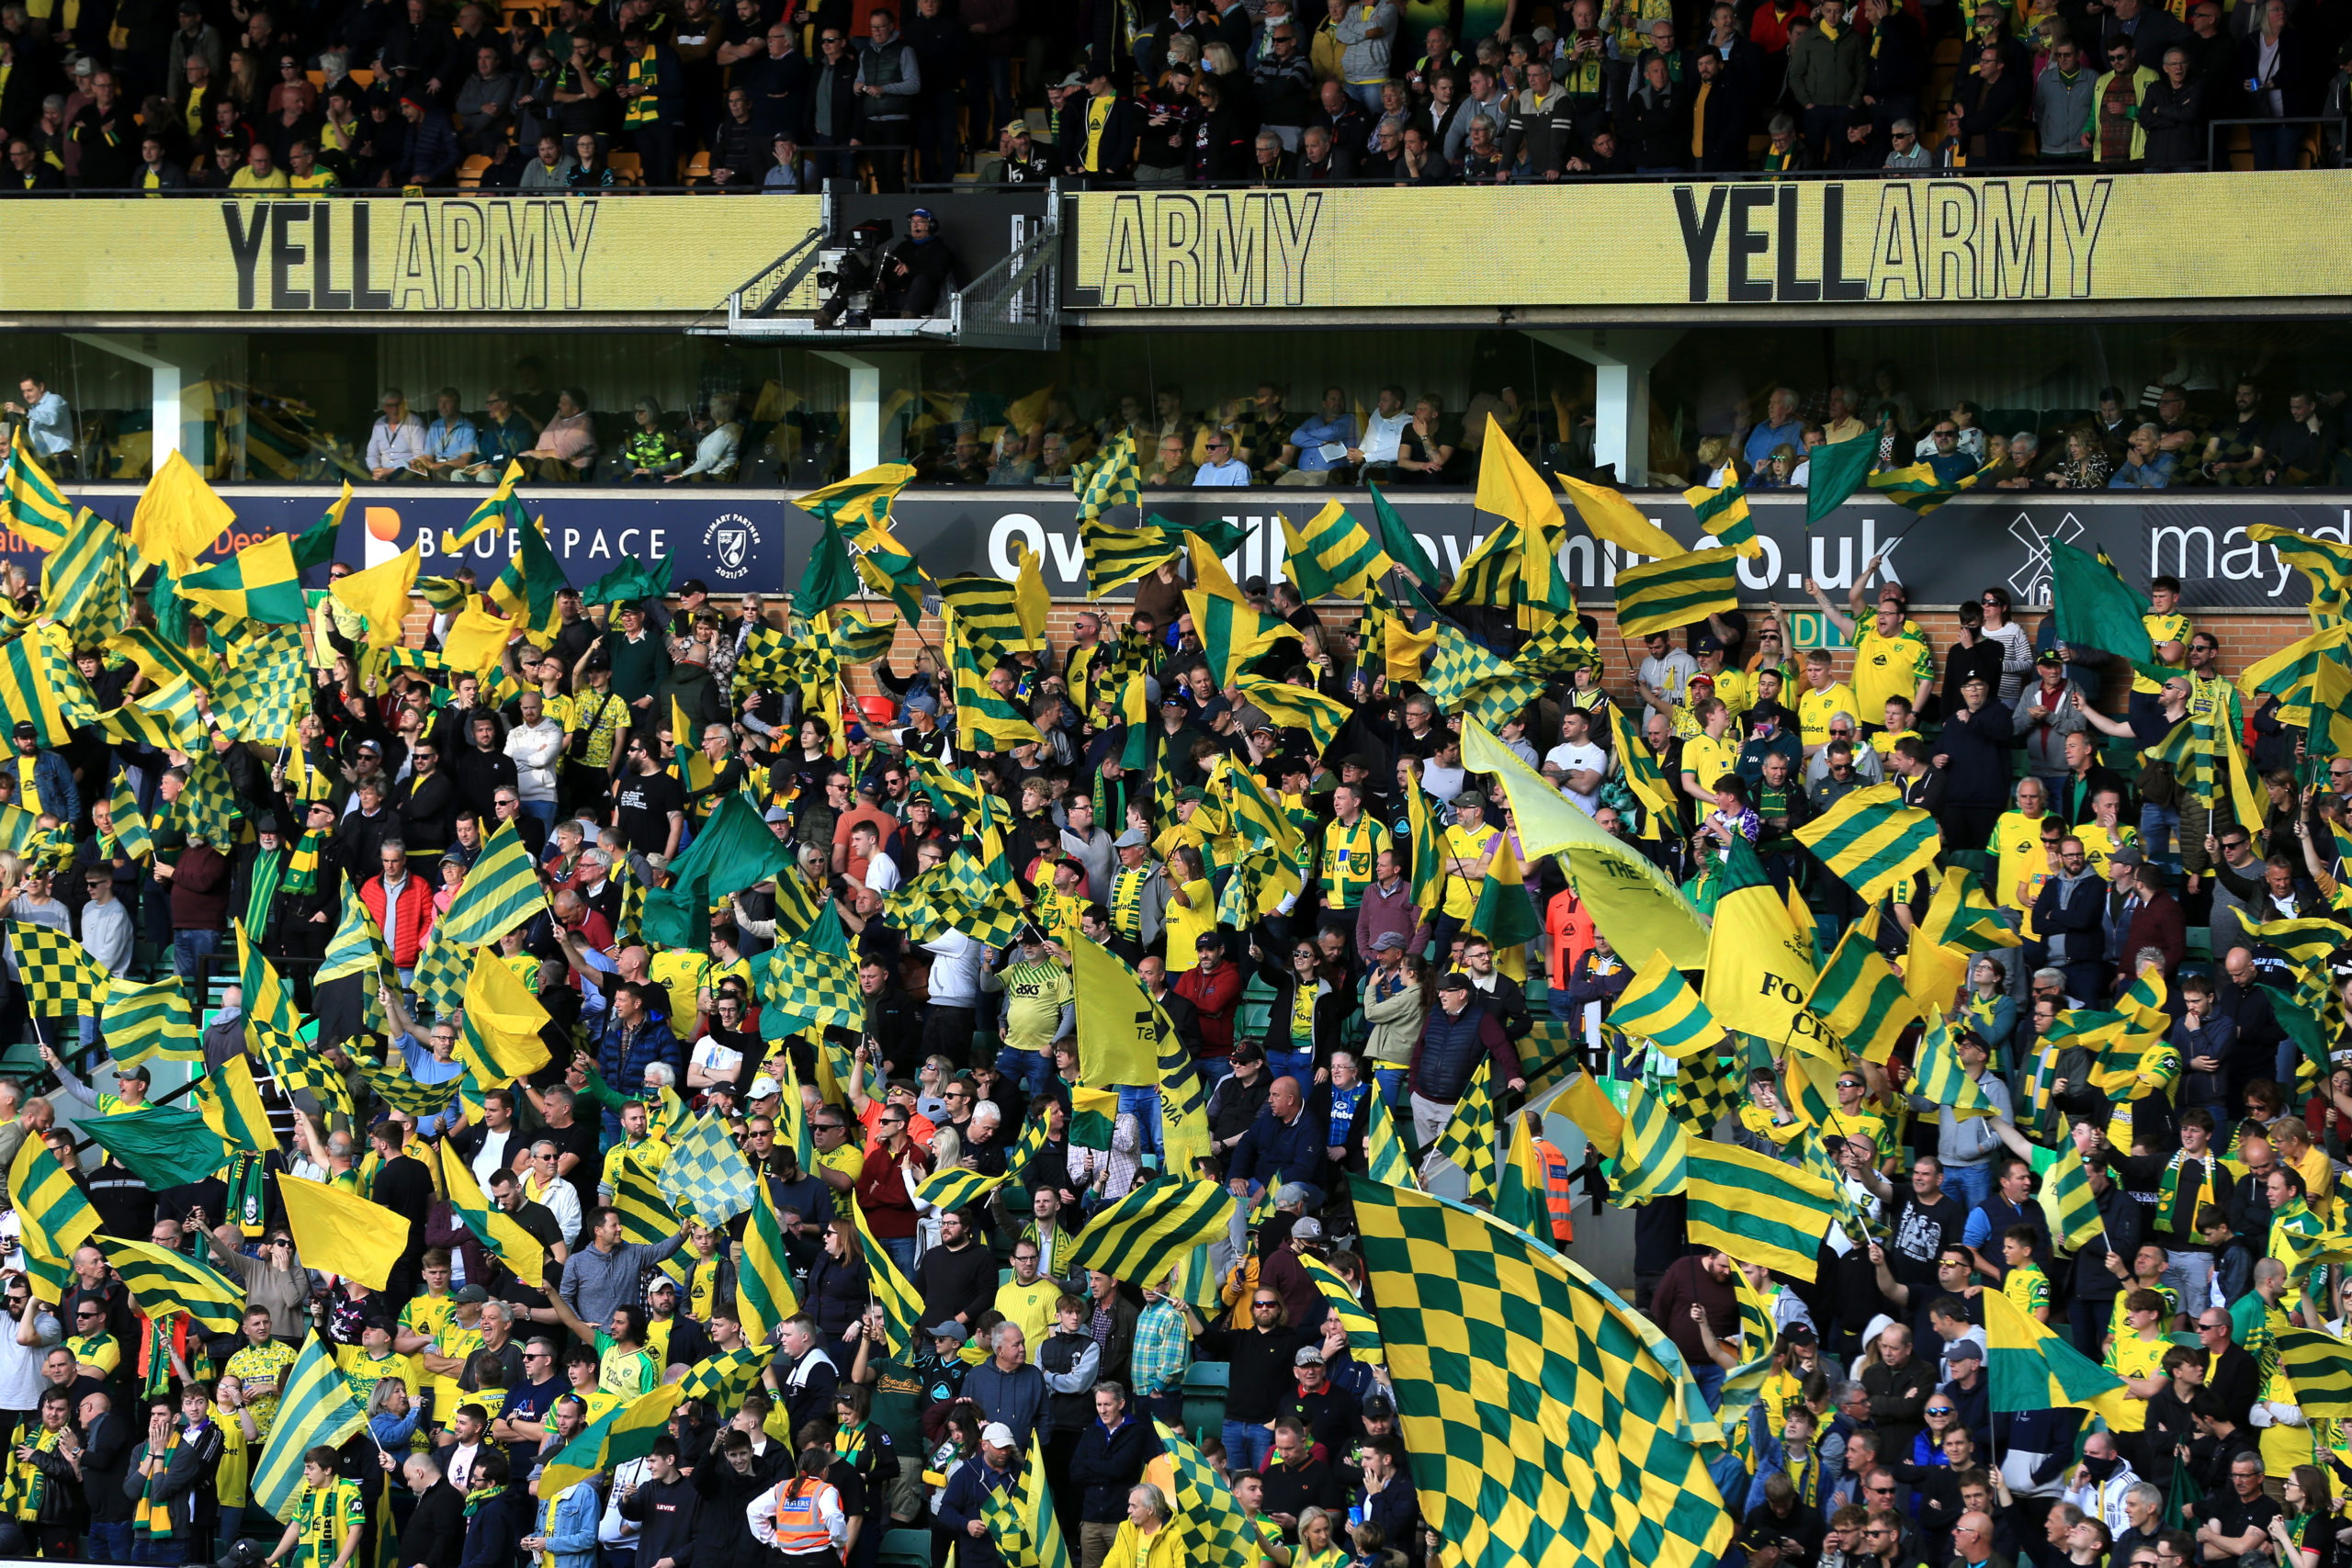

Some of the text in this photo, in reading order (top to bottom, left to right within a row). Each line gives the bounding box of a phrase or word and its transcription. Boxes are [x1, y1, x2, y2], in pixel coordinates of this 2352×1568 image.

[703, 513, 761, 545] PRIMARY PARTNER
[417, 527, 667, 559] BUEPACE
[715, 566, 749, 580] 2021/22
[1600, 860, 1640, 880] THE
[351, 1501, 363, 1512] JD
